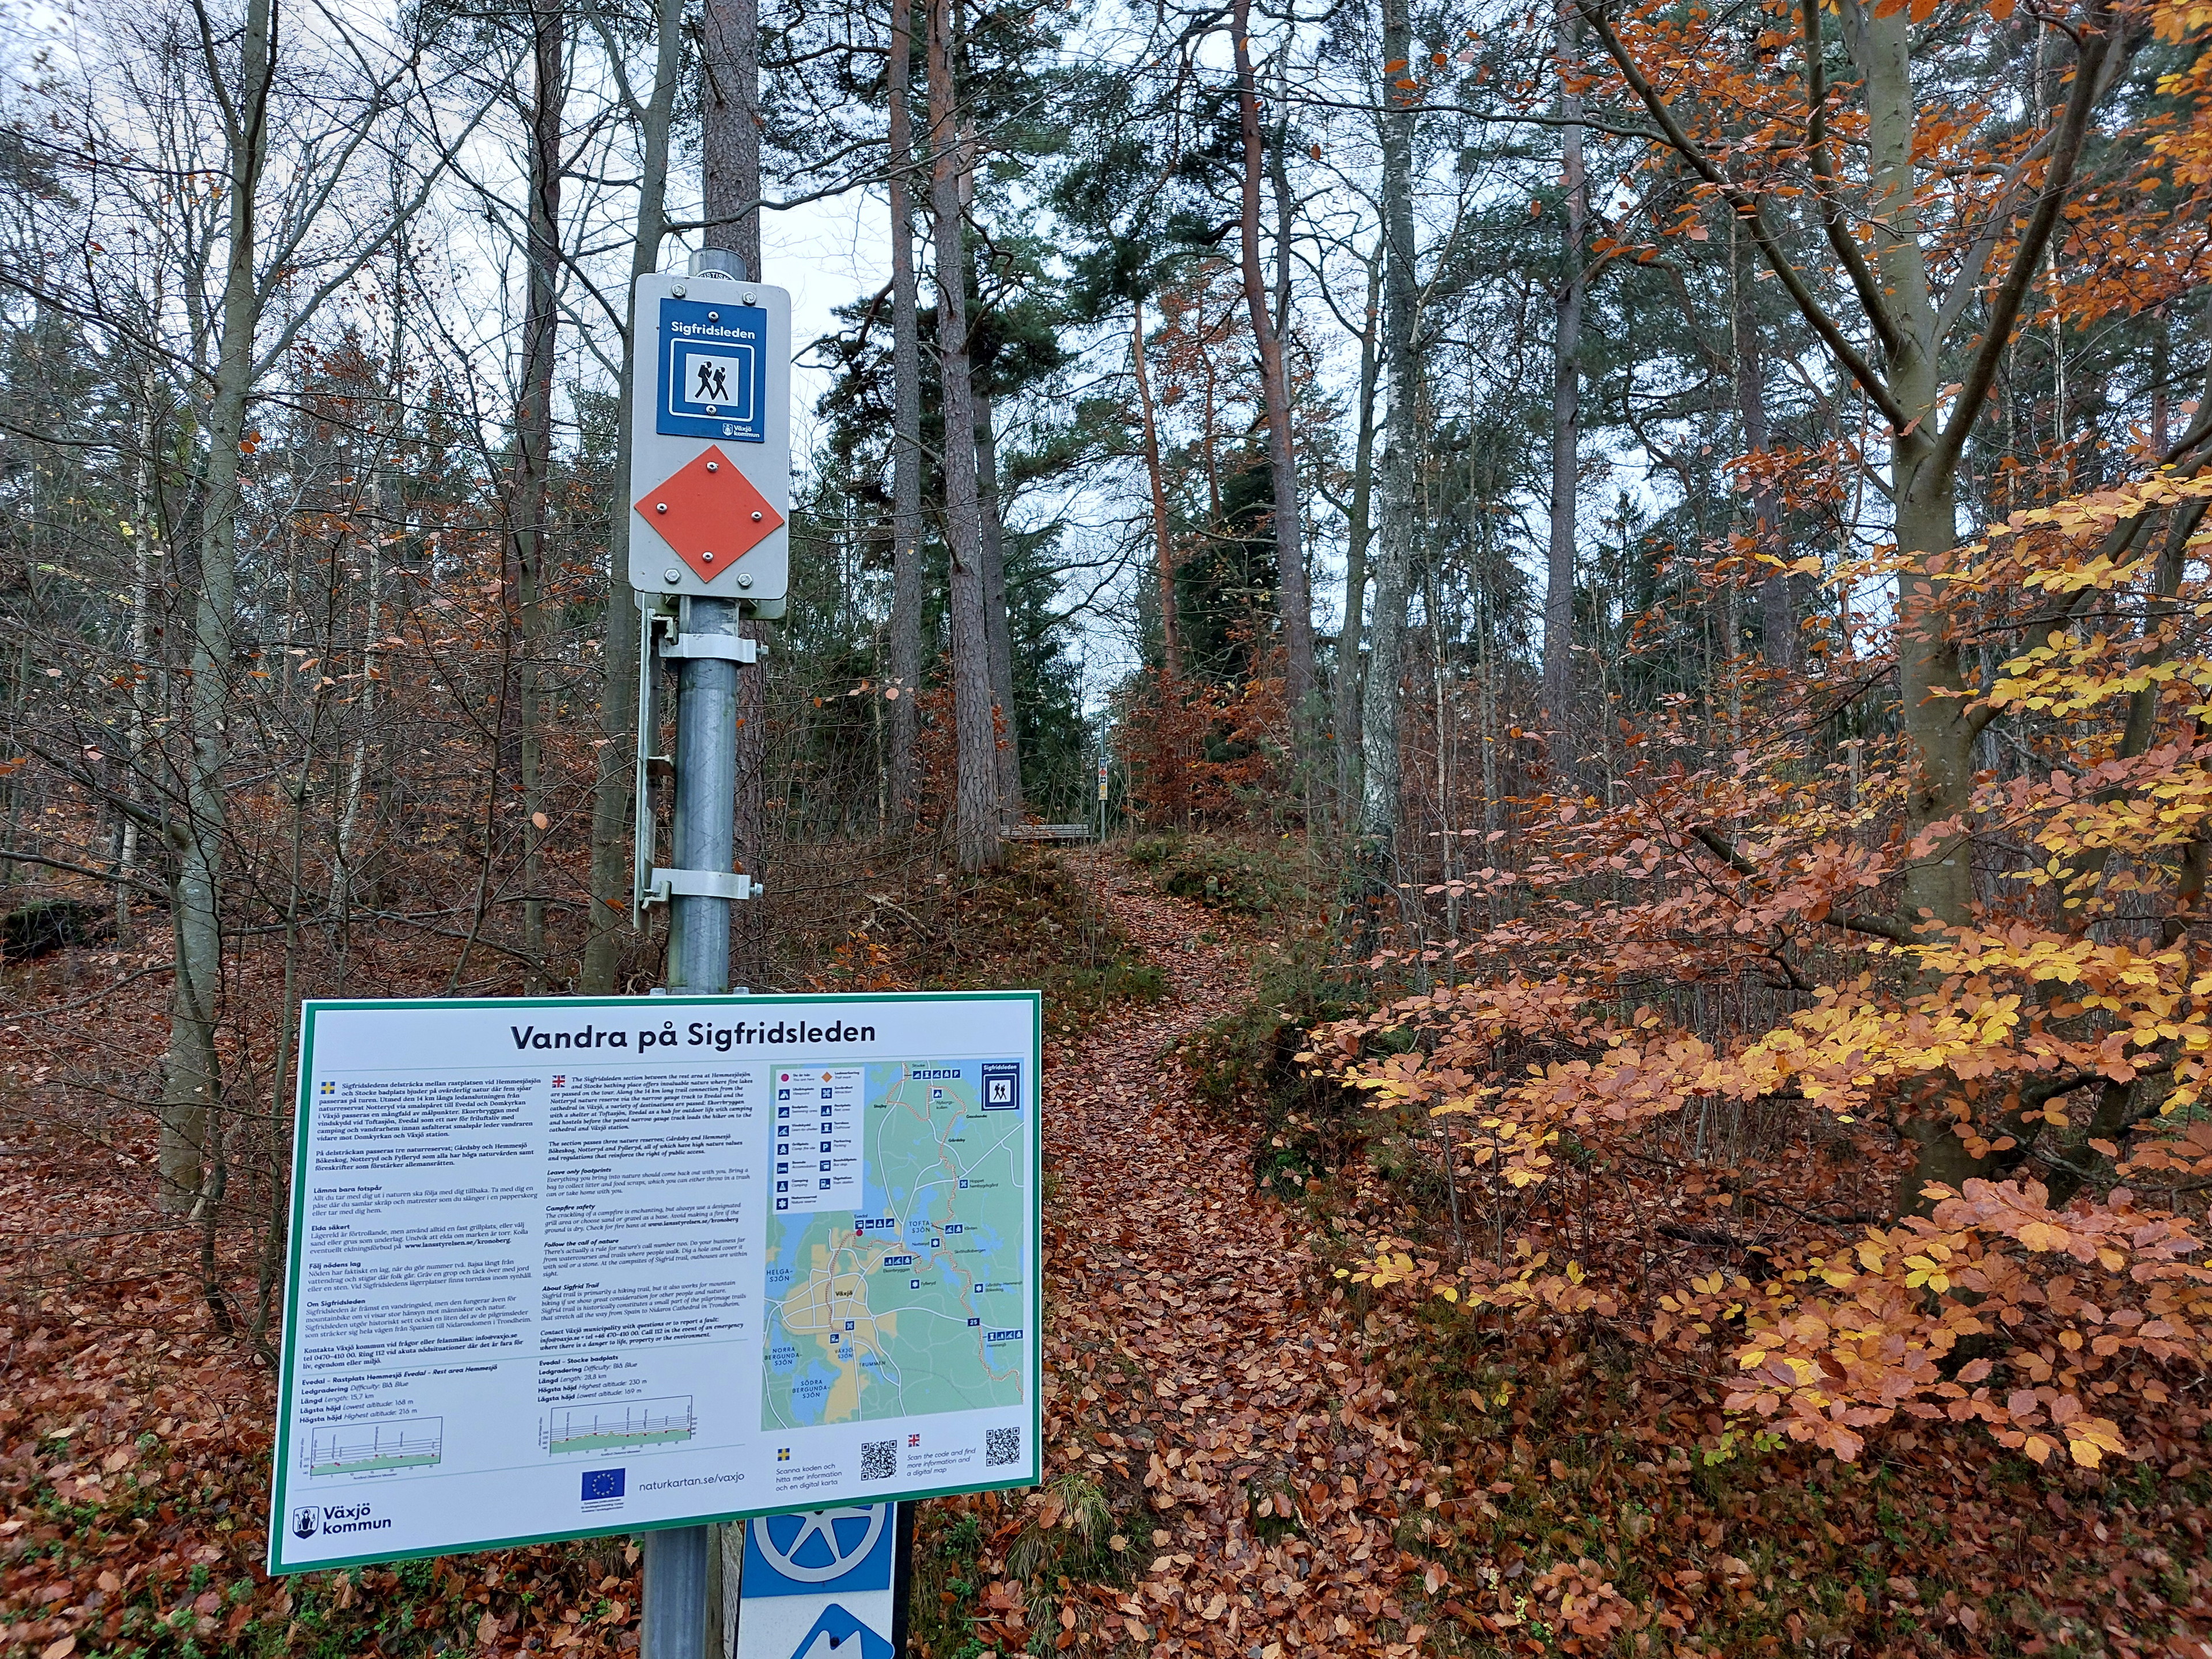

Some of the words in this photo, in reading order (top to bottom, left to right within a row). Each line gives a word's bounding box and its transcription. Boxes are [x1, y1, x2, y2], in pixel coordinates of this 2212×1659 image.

[671, 321, 756, 340] Sigfridsleden
[734, 425, 752, 433] Växjö
[734, 430, 760, 438] kommun
[510, 1025, 628, 1050] Vandra
[638, 1021, 678, 1054] på
[687, 1020, 875, 1052] Sigfridsleden
[983, 1064, 1017, 1072] Sigfridsleden
[357, 1184, 382, 1192] fotspår
[562, 1283, 585, 1291] Sigfrid
[320, 1298, 366, 1308] Sigfridsleden
[304, 1346, 335, 1354] Kontakta
[336, 1344, 354, 1353] Växjö
[437, 1336, 474, 1344] felanmälan:
[475, 1333, 518, 1341] info@vaxjo.se
[418, 1344, 467, 1353] nödsituationer
[314, 1361, 345, 1370] egendom
[363, 1357, 381, 1366] miljö.
[302, 1378, 325, 1386] Evedal
[332, 1376, 365, 1384] Rastplats
[366, 1372, 402, 1381] Hemmesjö
[464, 1363, 498, 1372] Hemmesjö
[539, 1367, 582, 1376] Ledgradering
[538, 1377, 559, 1385] Längd
[301, 1387, 349, 1396] Ledgradering
[563, 1384, 577, 1392] höjd
[300, 1397, 323, 1405] Längd
[560, 1393, 575, 1402] höjd
[300, 1407, 324, 1415] Lägsta
[325, 1404, 341, 1413] höjd
[299, 1416, 325, 1424] Högsta
[327, 1414, 342, 1422] höjd
[964, 1447, 976, 1456] find
[923, 1458, 957, 1468] information
[957, 1455, 971, 1463] and
[806, 1471, 842, 1480] information
[912, 1467, 933, 1477] digital
[639, 1472, 745, 1491] naturkartan.se/vaxjo
[799, 1480, 820, 1490] digital
[323, 1502, 371, 1520] Växjö
[323, 1518, 392, 1535] kommun
